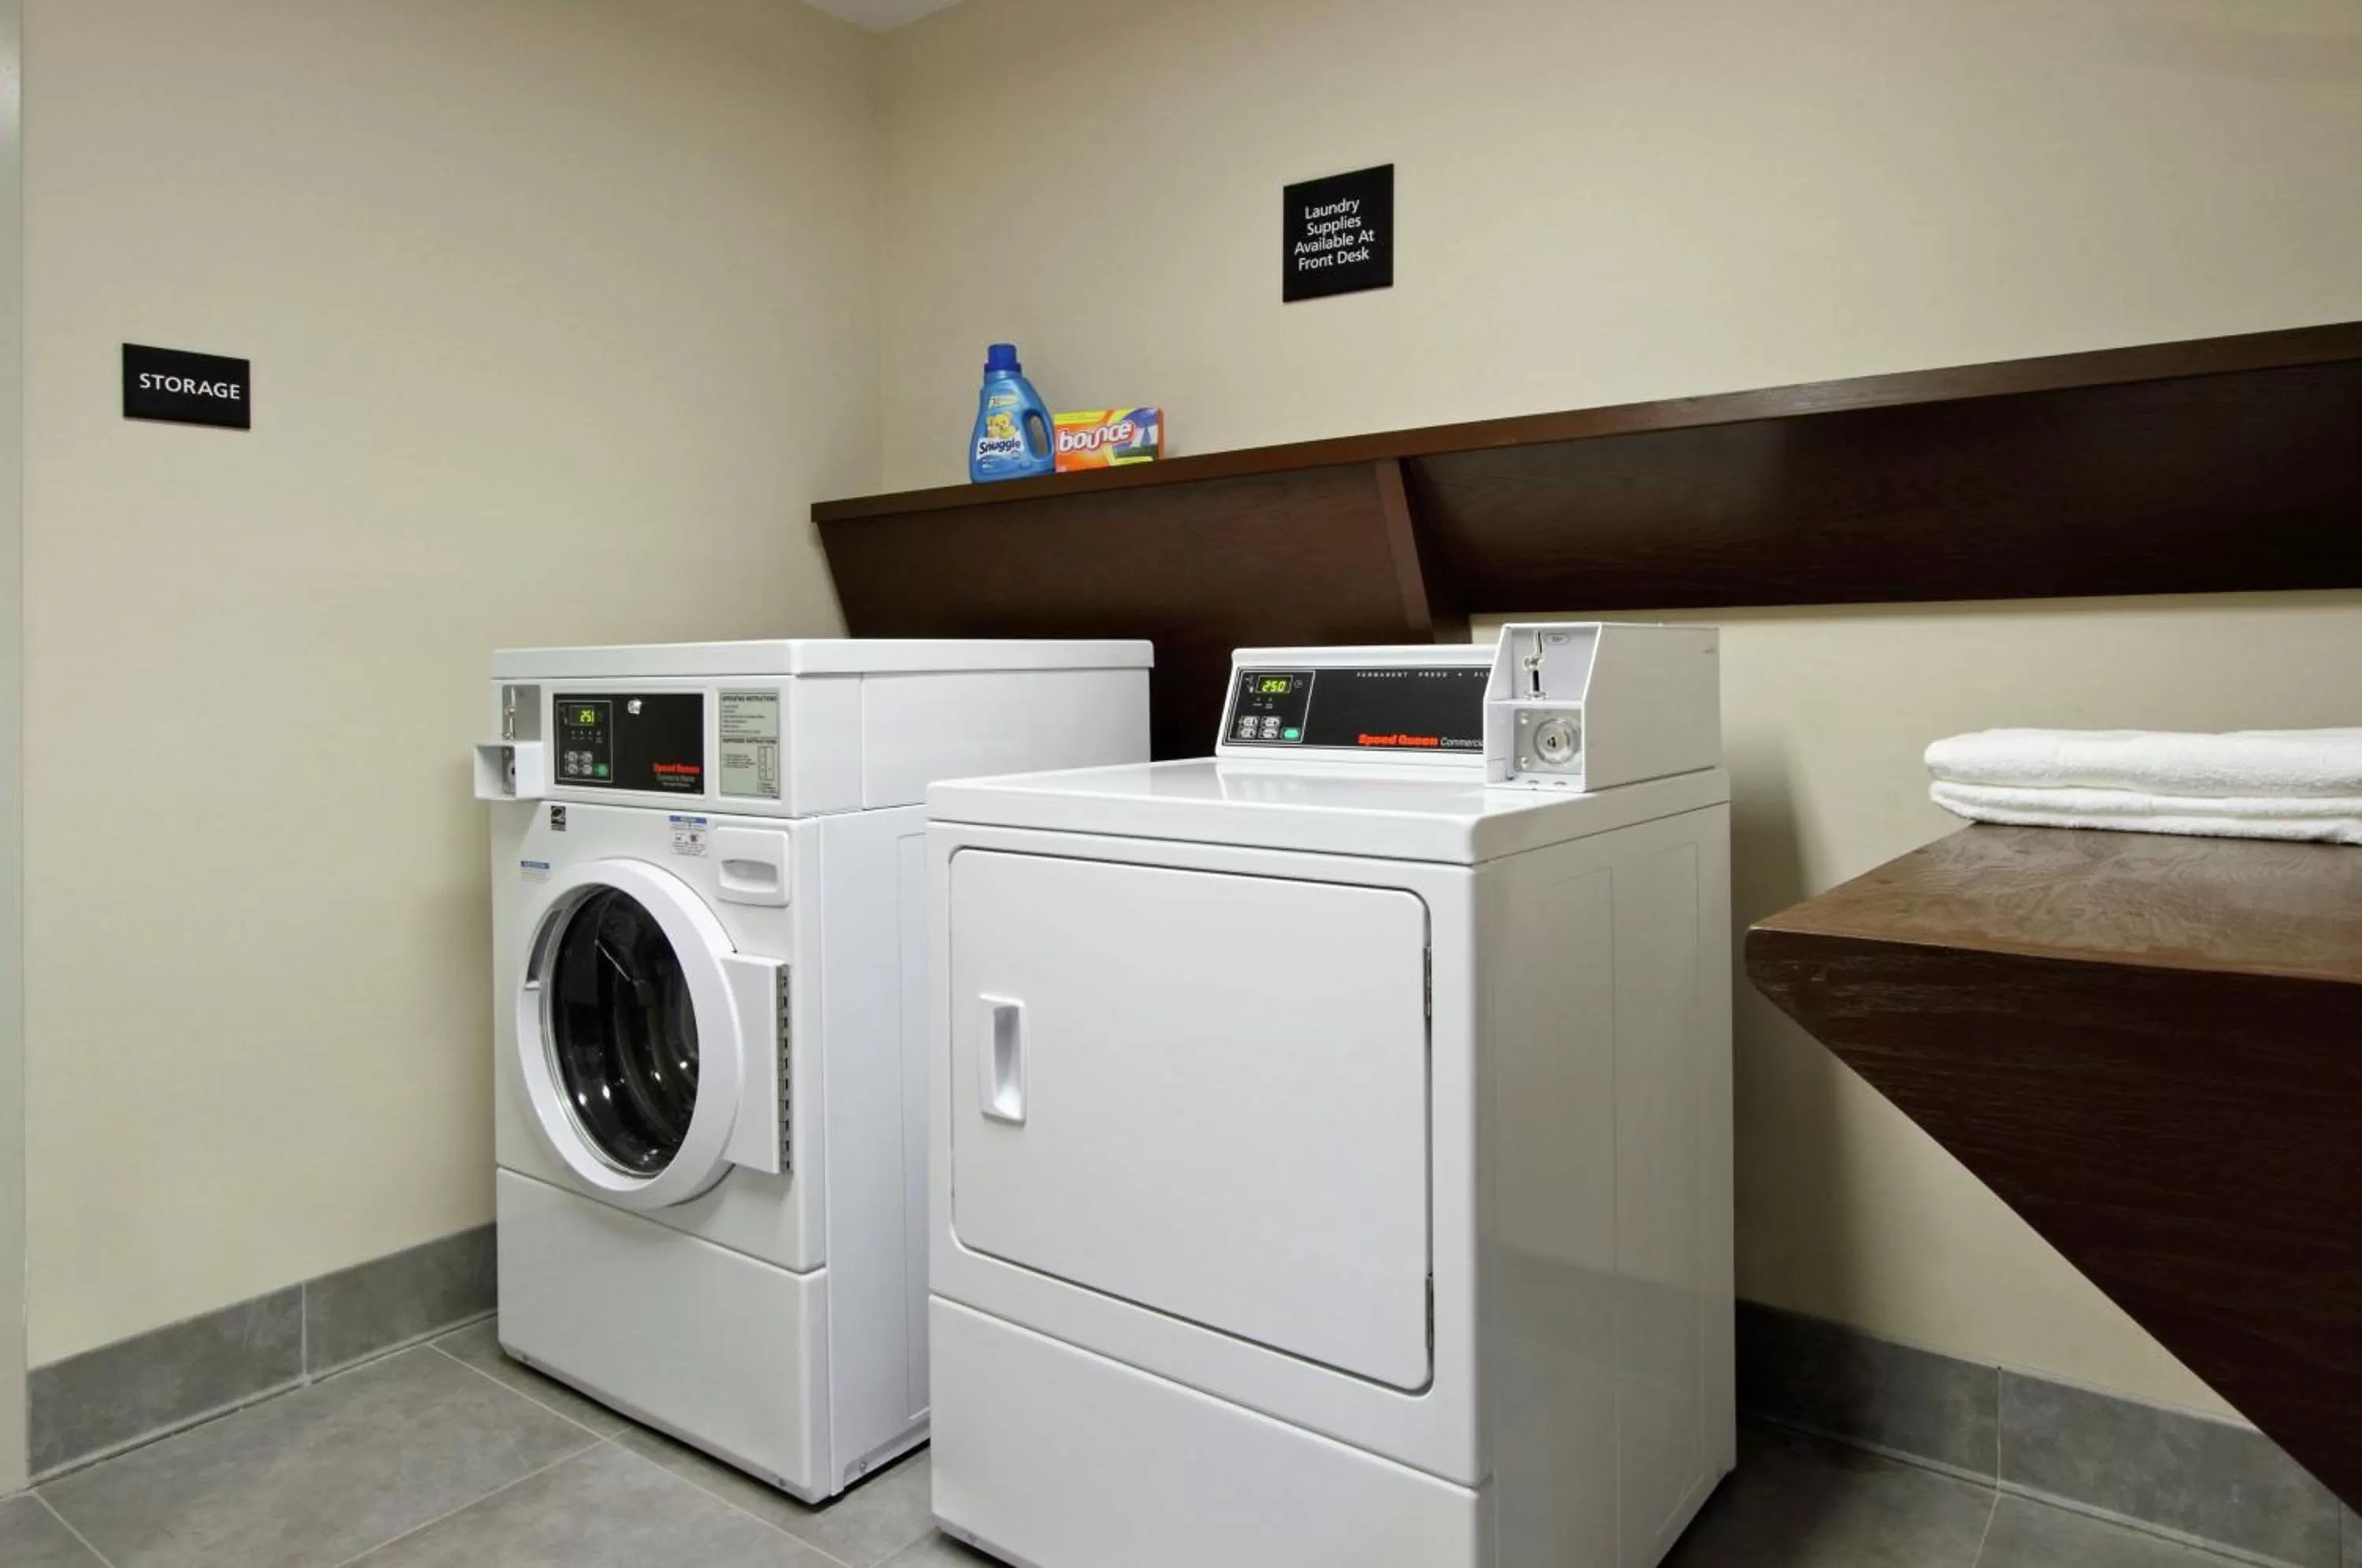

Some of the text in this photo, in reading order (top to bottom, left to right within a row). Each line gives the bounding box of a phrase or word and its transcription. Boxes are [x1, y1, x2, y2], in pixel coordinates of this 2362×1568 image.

[1305, 198, 1360, 220] Laundry
[1307, 216, 1361, 236] Supplies
[1294, 229, 1375, 256] Available At
[1298, 246, 1370, 271] Front Desk
[139, 372, 240, 399] STORAGE
[979, 438, 1021, 454] Snuggle
[1059, 421, 1132, 452] bounce
[1359, 734, 1398, 746] Speed
[1398, 734, 1438, 746] Queen
